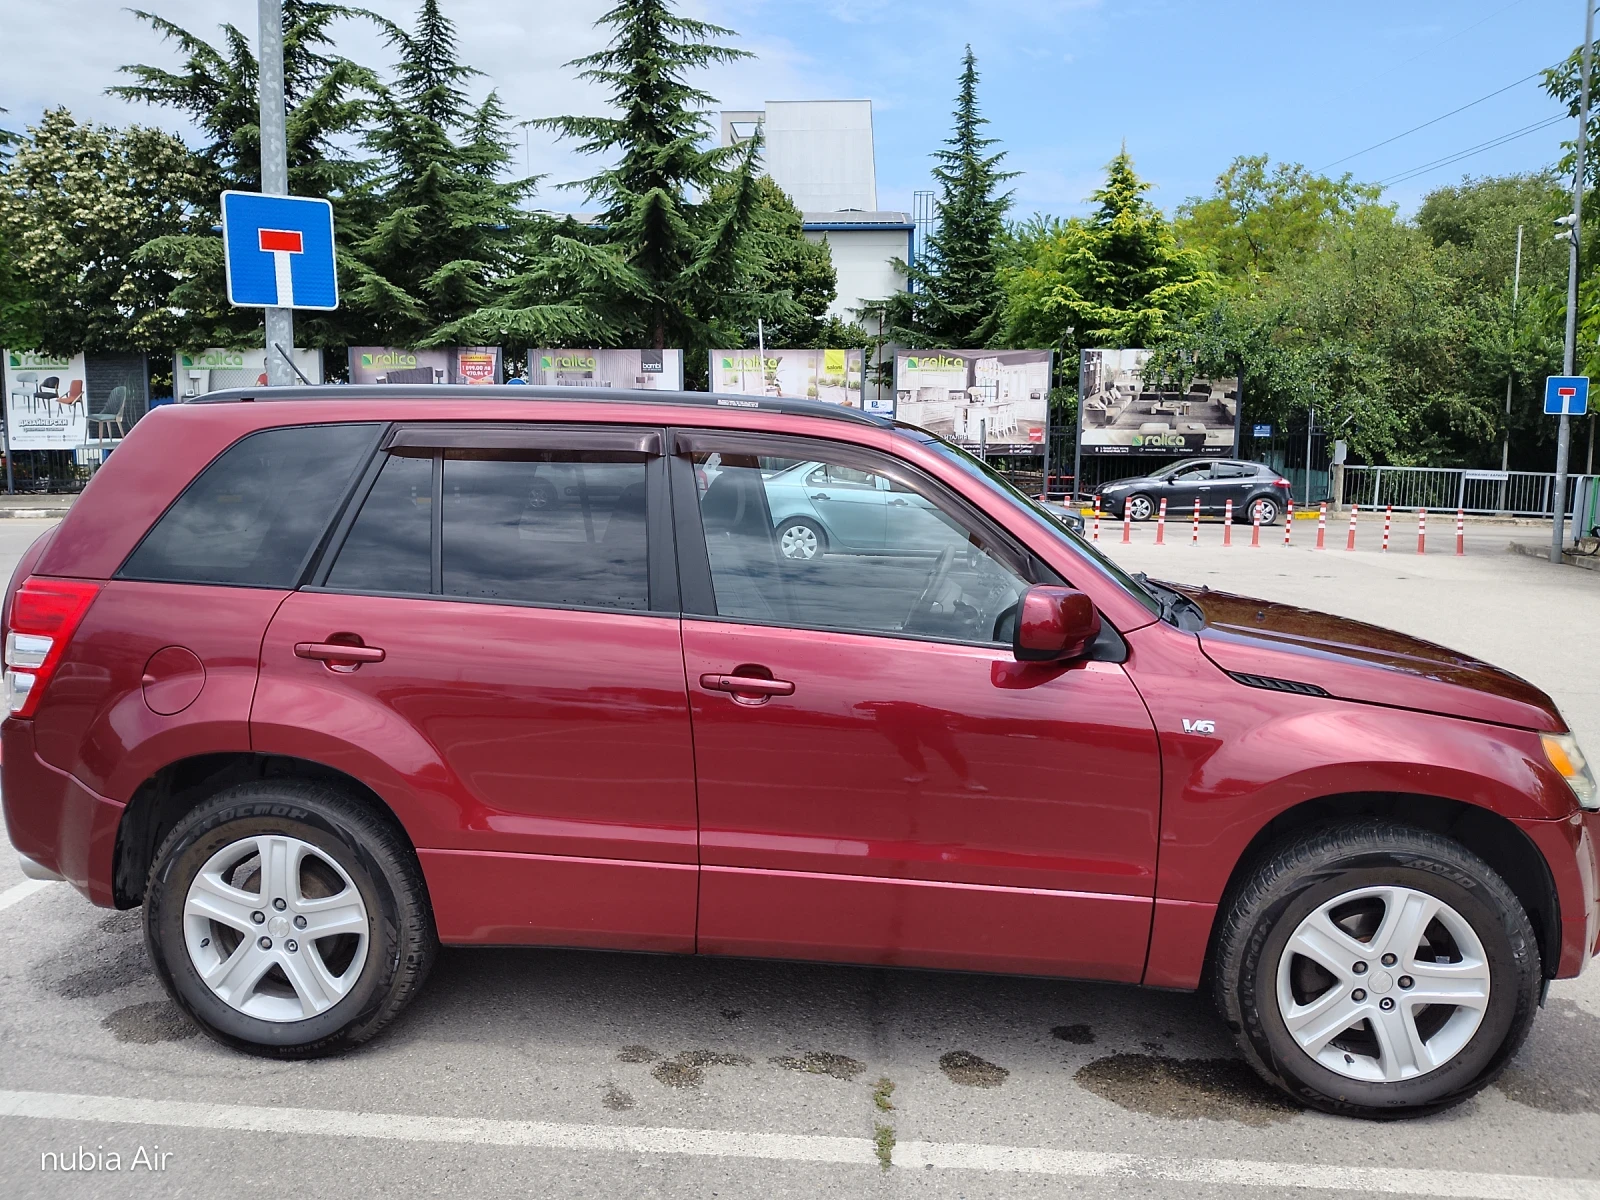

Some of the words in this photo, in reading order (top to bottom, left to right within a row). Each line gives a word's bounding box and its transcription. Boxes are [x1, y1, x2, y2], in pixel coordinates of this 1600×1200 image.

[197, 350, 243, 366] ralica
[375, 351, 417, 365] ralica
[555, 354, 596, 368] ralica
[922, 353, 963, 368] ralica
[1144, 432, 1186, 447] ralica
[1181, 718, 1216, 734] V6
